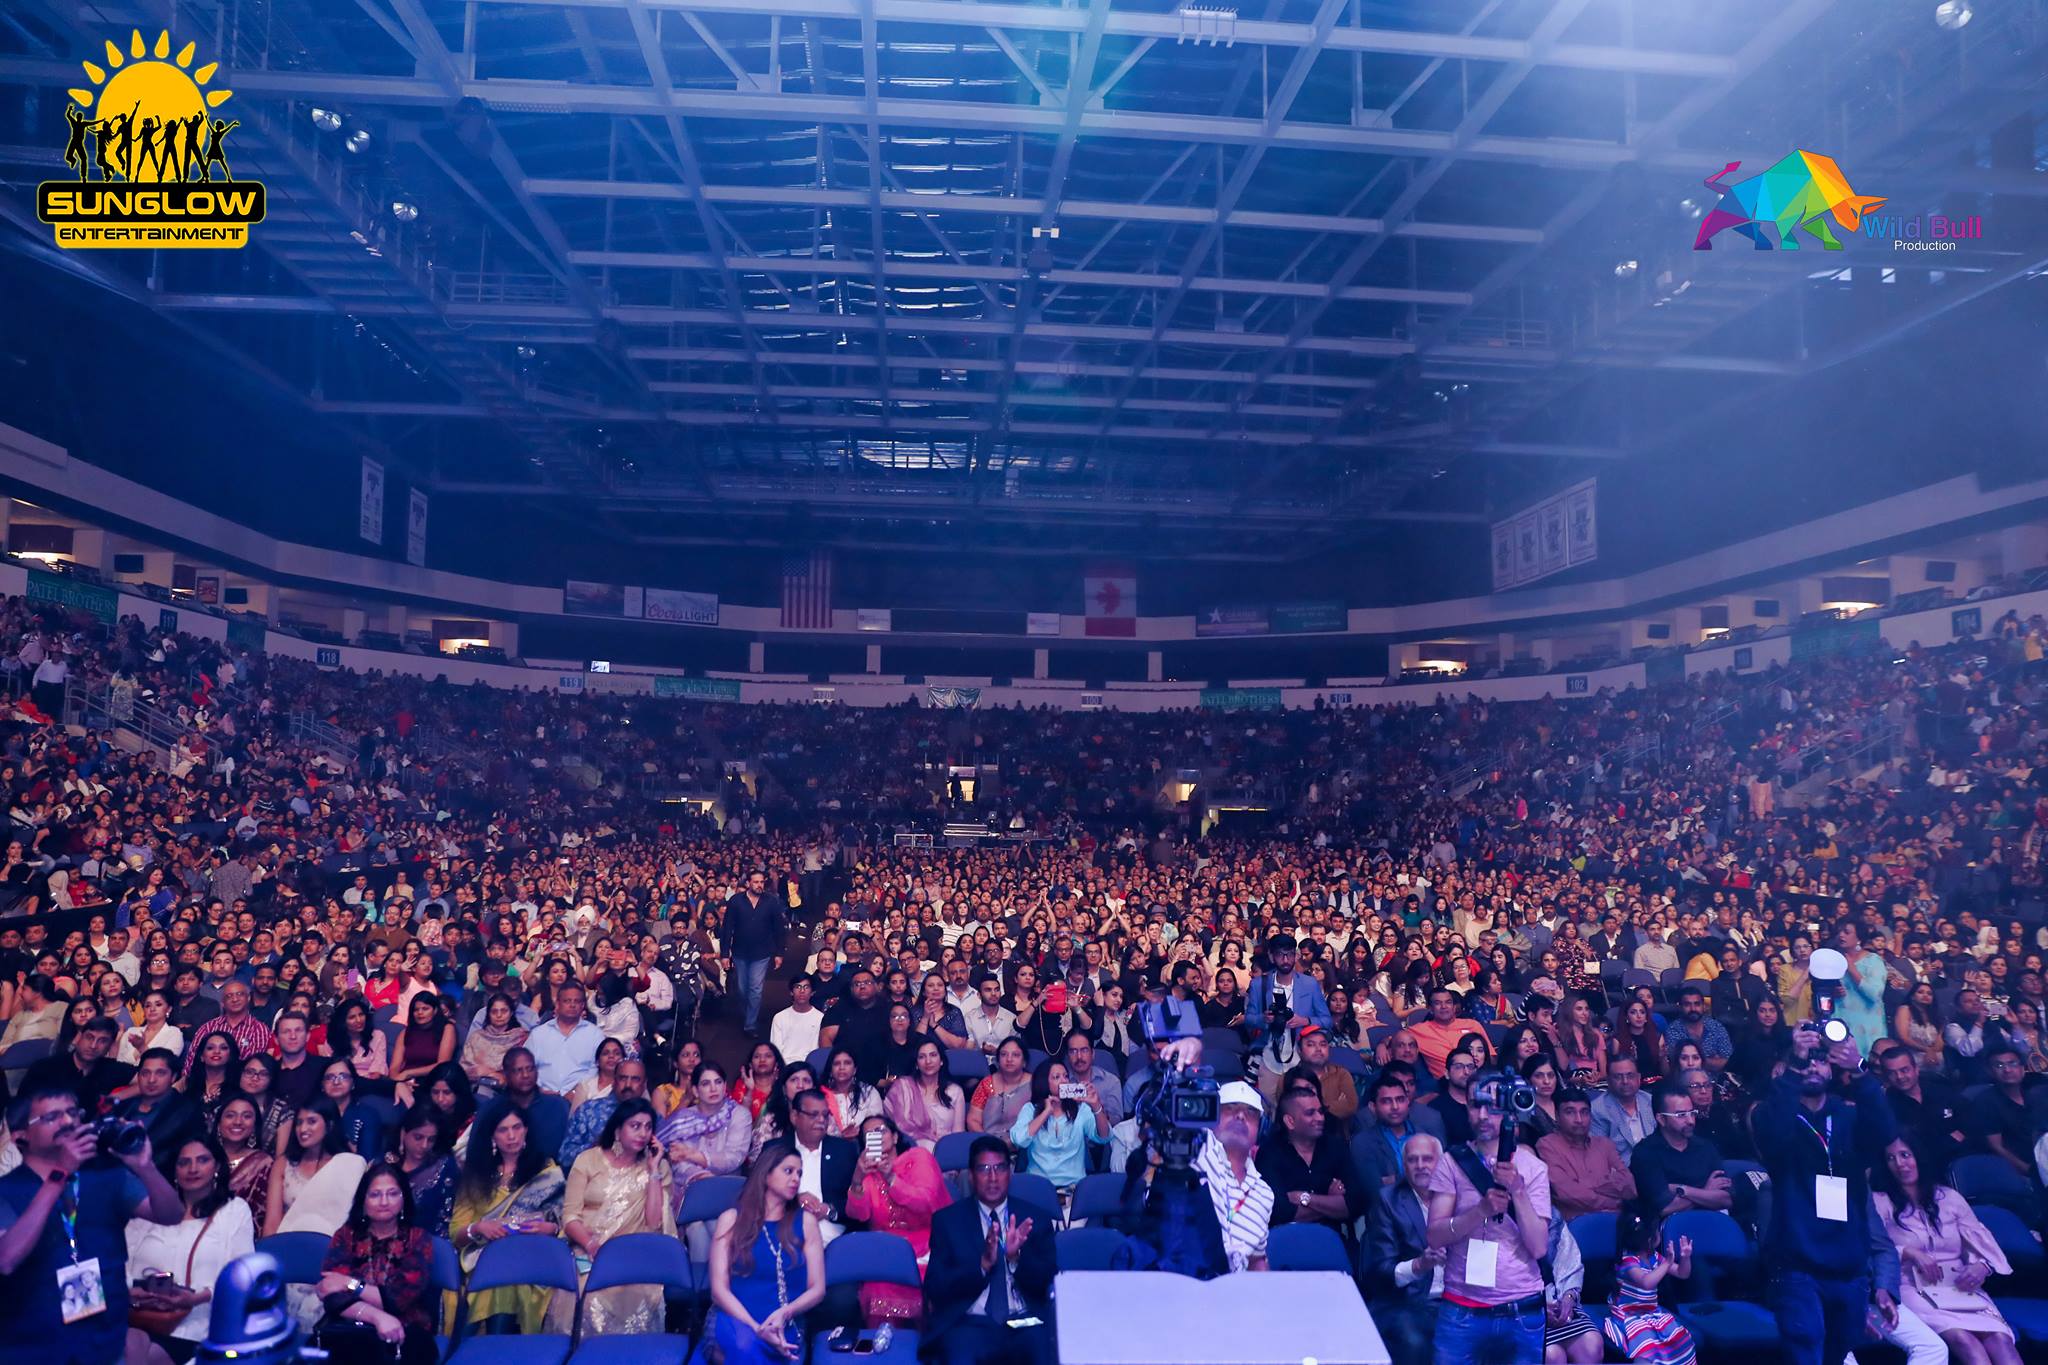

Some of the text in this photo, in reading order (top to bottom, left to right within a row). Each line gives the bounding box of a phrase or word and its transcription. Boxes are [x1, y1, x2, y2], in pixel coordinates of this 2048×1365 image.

[27, 580, 117, 612] PATEL BROTHERS
[647, 603, 716, 623] Coors LIGHT
[320, 651, 337, 664] 118
[1570, 680, 1585, 690] 102
